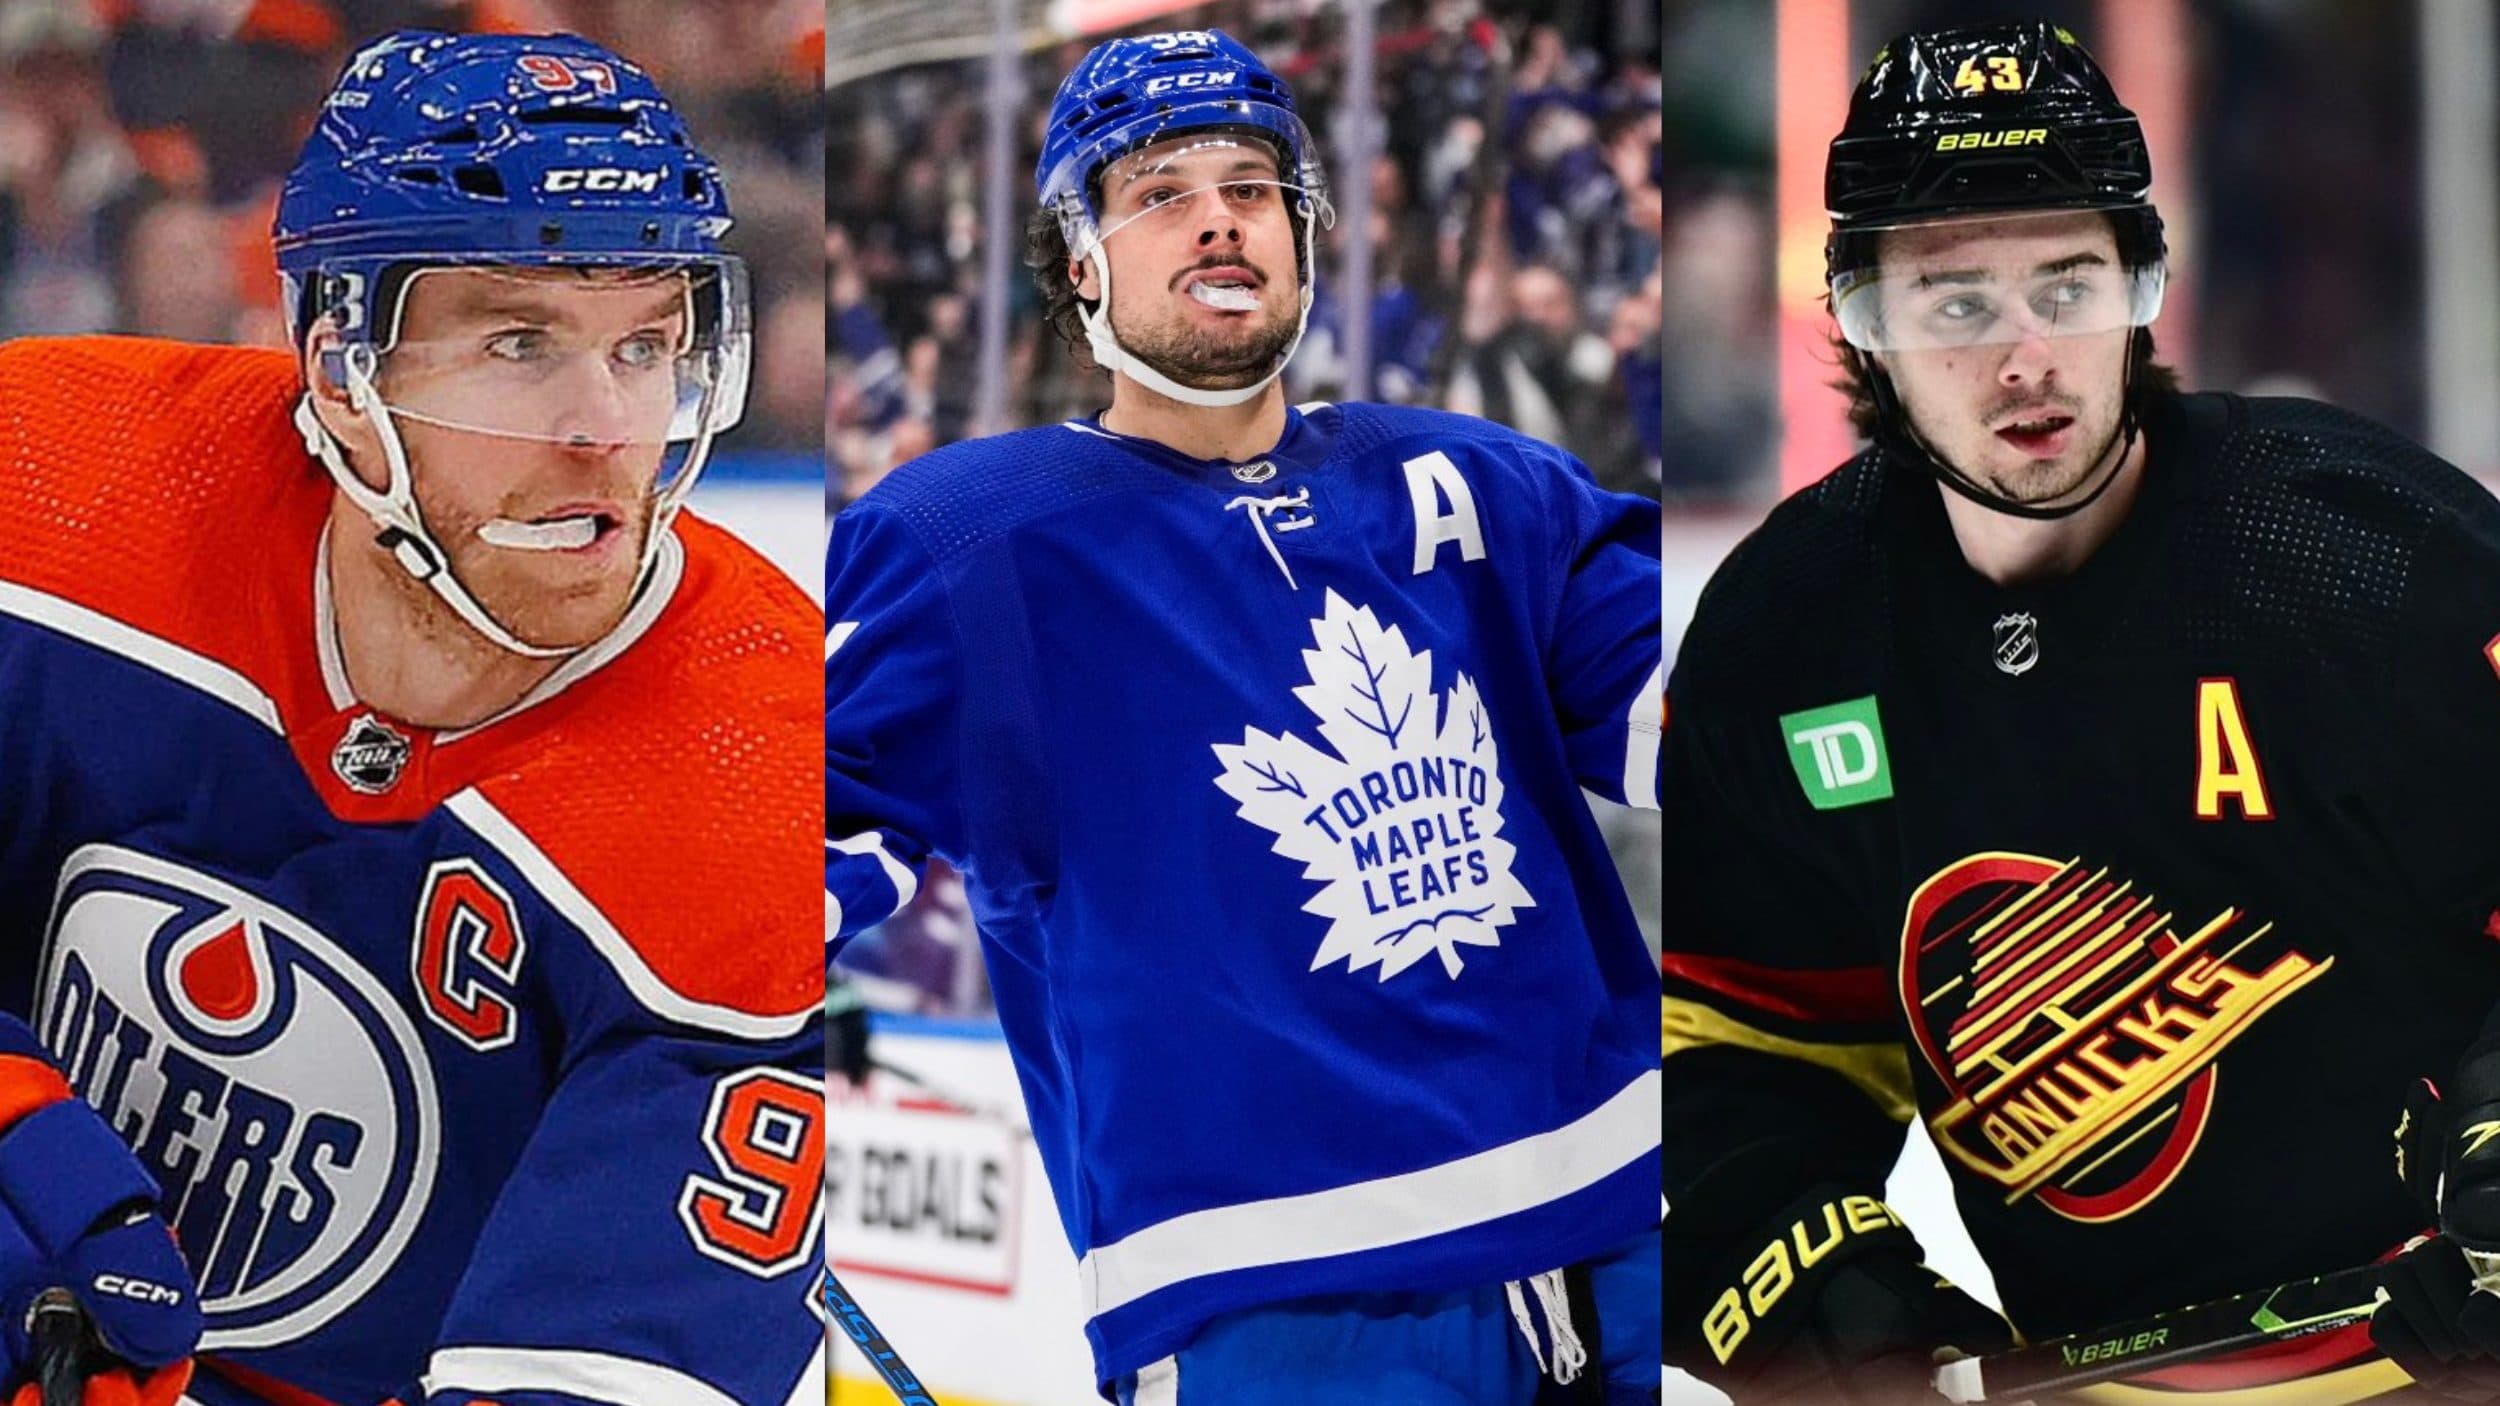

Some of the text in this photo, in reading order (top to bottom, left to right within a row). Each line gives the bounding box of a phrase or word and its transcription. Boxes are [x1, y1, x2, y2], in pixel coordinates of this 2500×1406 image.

[516, 55, 617, 95] 97
[1145, 71, 1237, 95] CCM
[1953, 55, 2023, 93] 43
[543, 167, 659, 193] CCM
[1401, 449, 1487, 576] A
[1793, 720, 1878, 790] TD
[2193, 676, 2276, 821] A
[1303, 755, 1487, 845] TORONTO
[1350, 805, 1482, 872] MAPLE
[1361, 849, 1490, 916] LEAFS
[411, 856, 526, 1052] C
[48, 948, 364, 1298] OILERS
[677, 1065, 825, 1322] 9
[94, 1275, 181, 1305] CCM
[825, 1268, 940, 1406] JETSP
